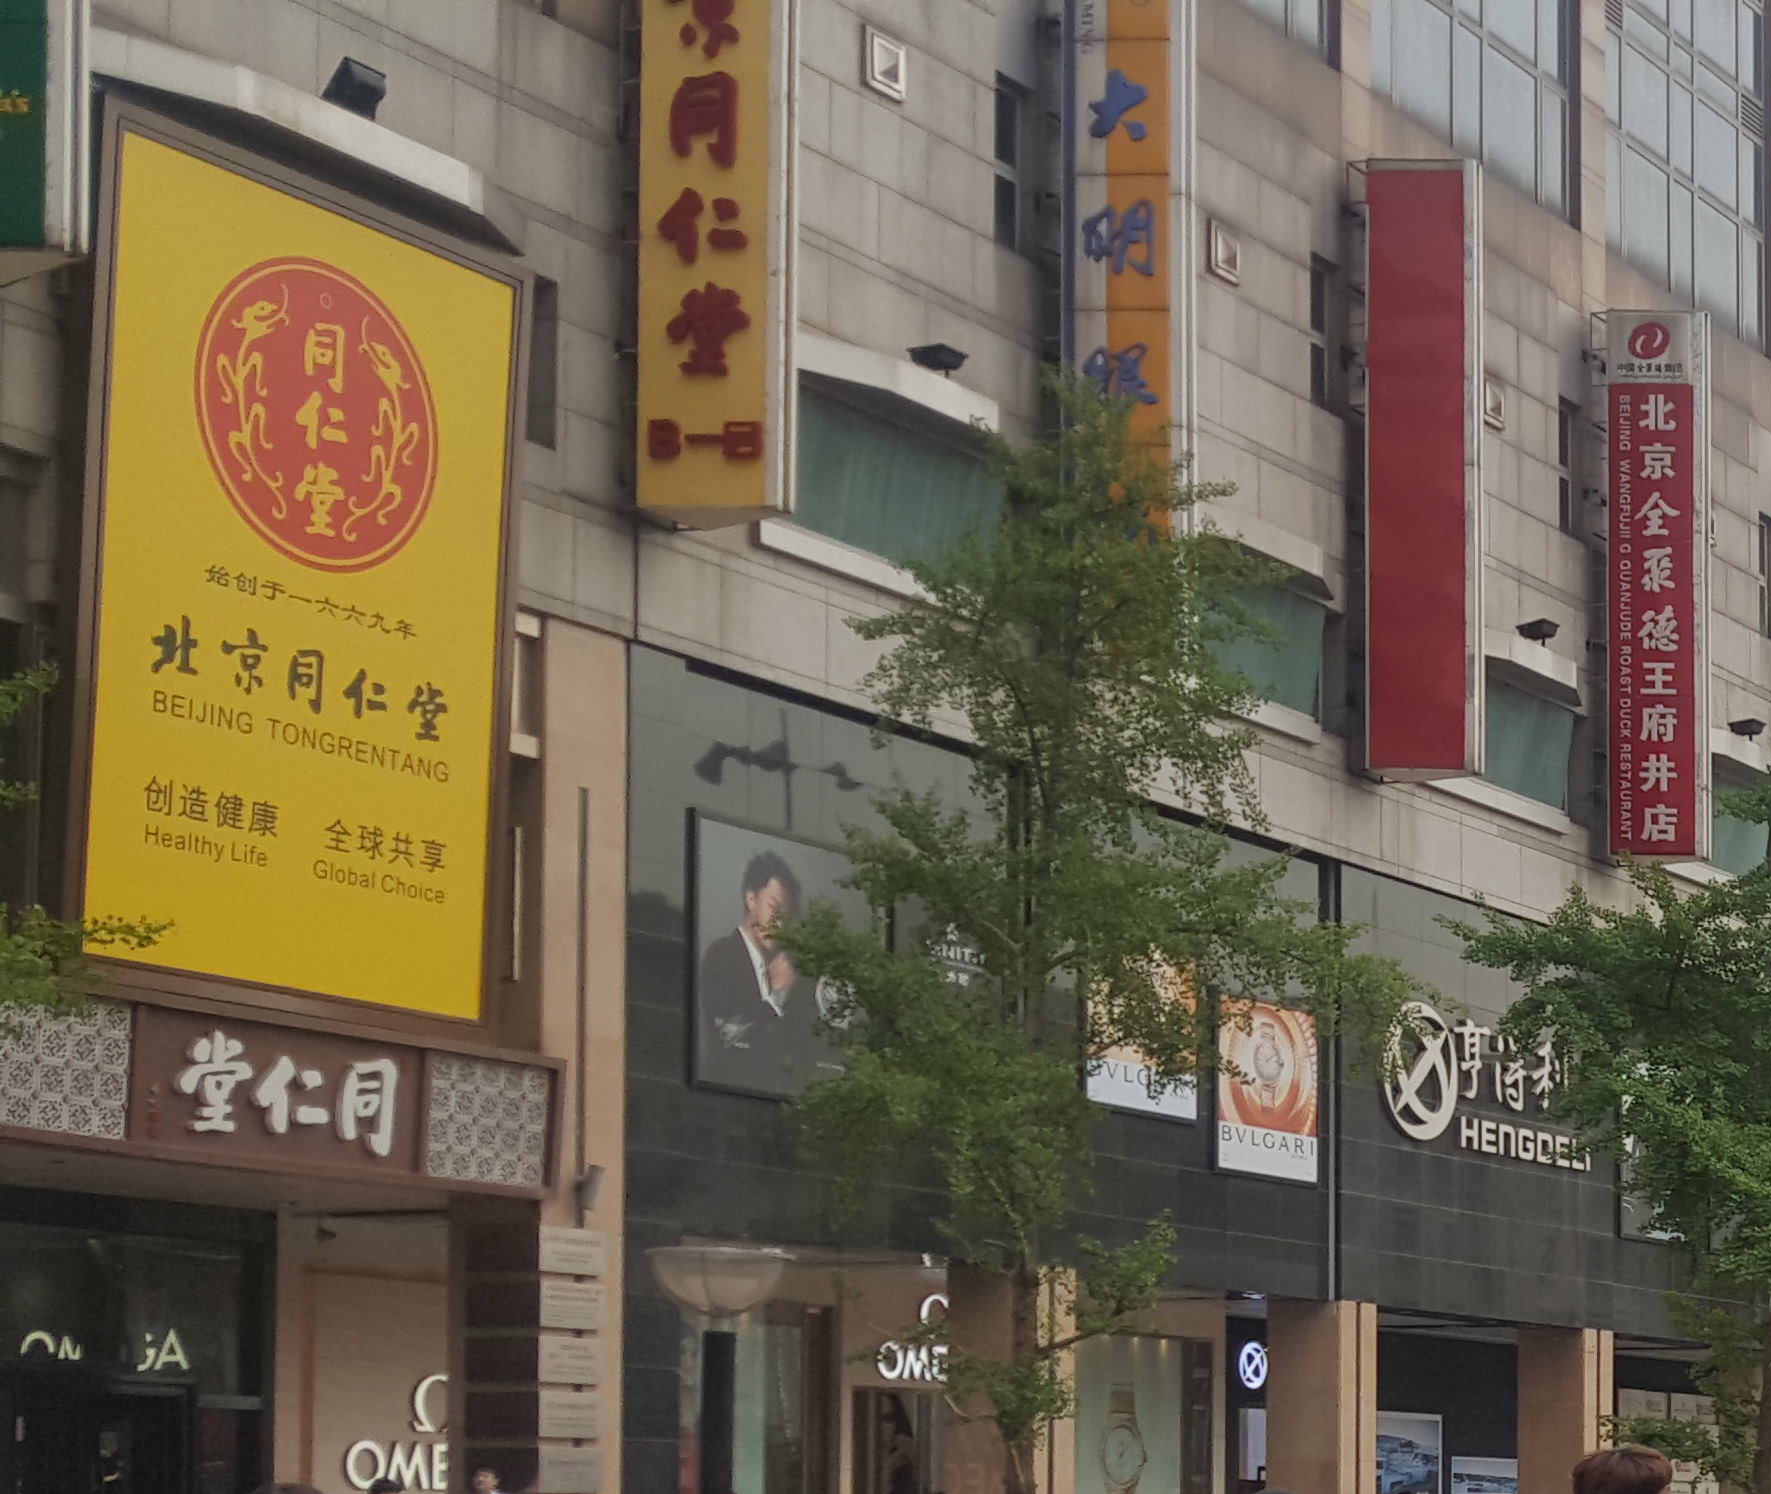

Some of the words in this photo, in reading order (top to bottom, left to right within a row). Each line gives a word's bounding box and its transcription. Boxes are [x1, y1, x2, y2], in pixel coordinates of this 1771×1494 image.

[295, 321, 347, 543] 同仁堂
[1619, 394, 1631, 451] BEIJING
[204, 564, 417, 640] 始创于一六六九年
[1619, 560, 1632, 640] QUANJUDE
[1634, 393, 1681, 842] 北京全聚德王府井店
[150, 615, 450, 743] 北京同仁堂
[1619, 646, 1632, 694] ROAST
[152, 690, 253, 735] BEIJING
[267, 717, 450, 783] TONGRENTANG
[1619, 699, 1632, 738] DUCK
[144, 776, 280, 838] 创造健康
[1619, 743, 1633, 840] RESTAURANT
[144, 824, 224, 863] Healthy
[231, 845, 268, 867] Life
[324, 818, 447, 874] 全球共享
[313, 859, 376, 890] Global
[381, 874, 446, 904] Choice
[1221, 1124, 1314, 1156] BVLGARI
